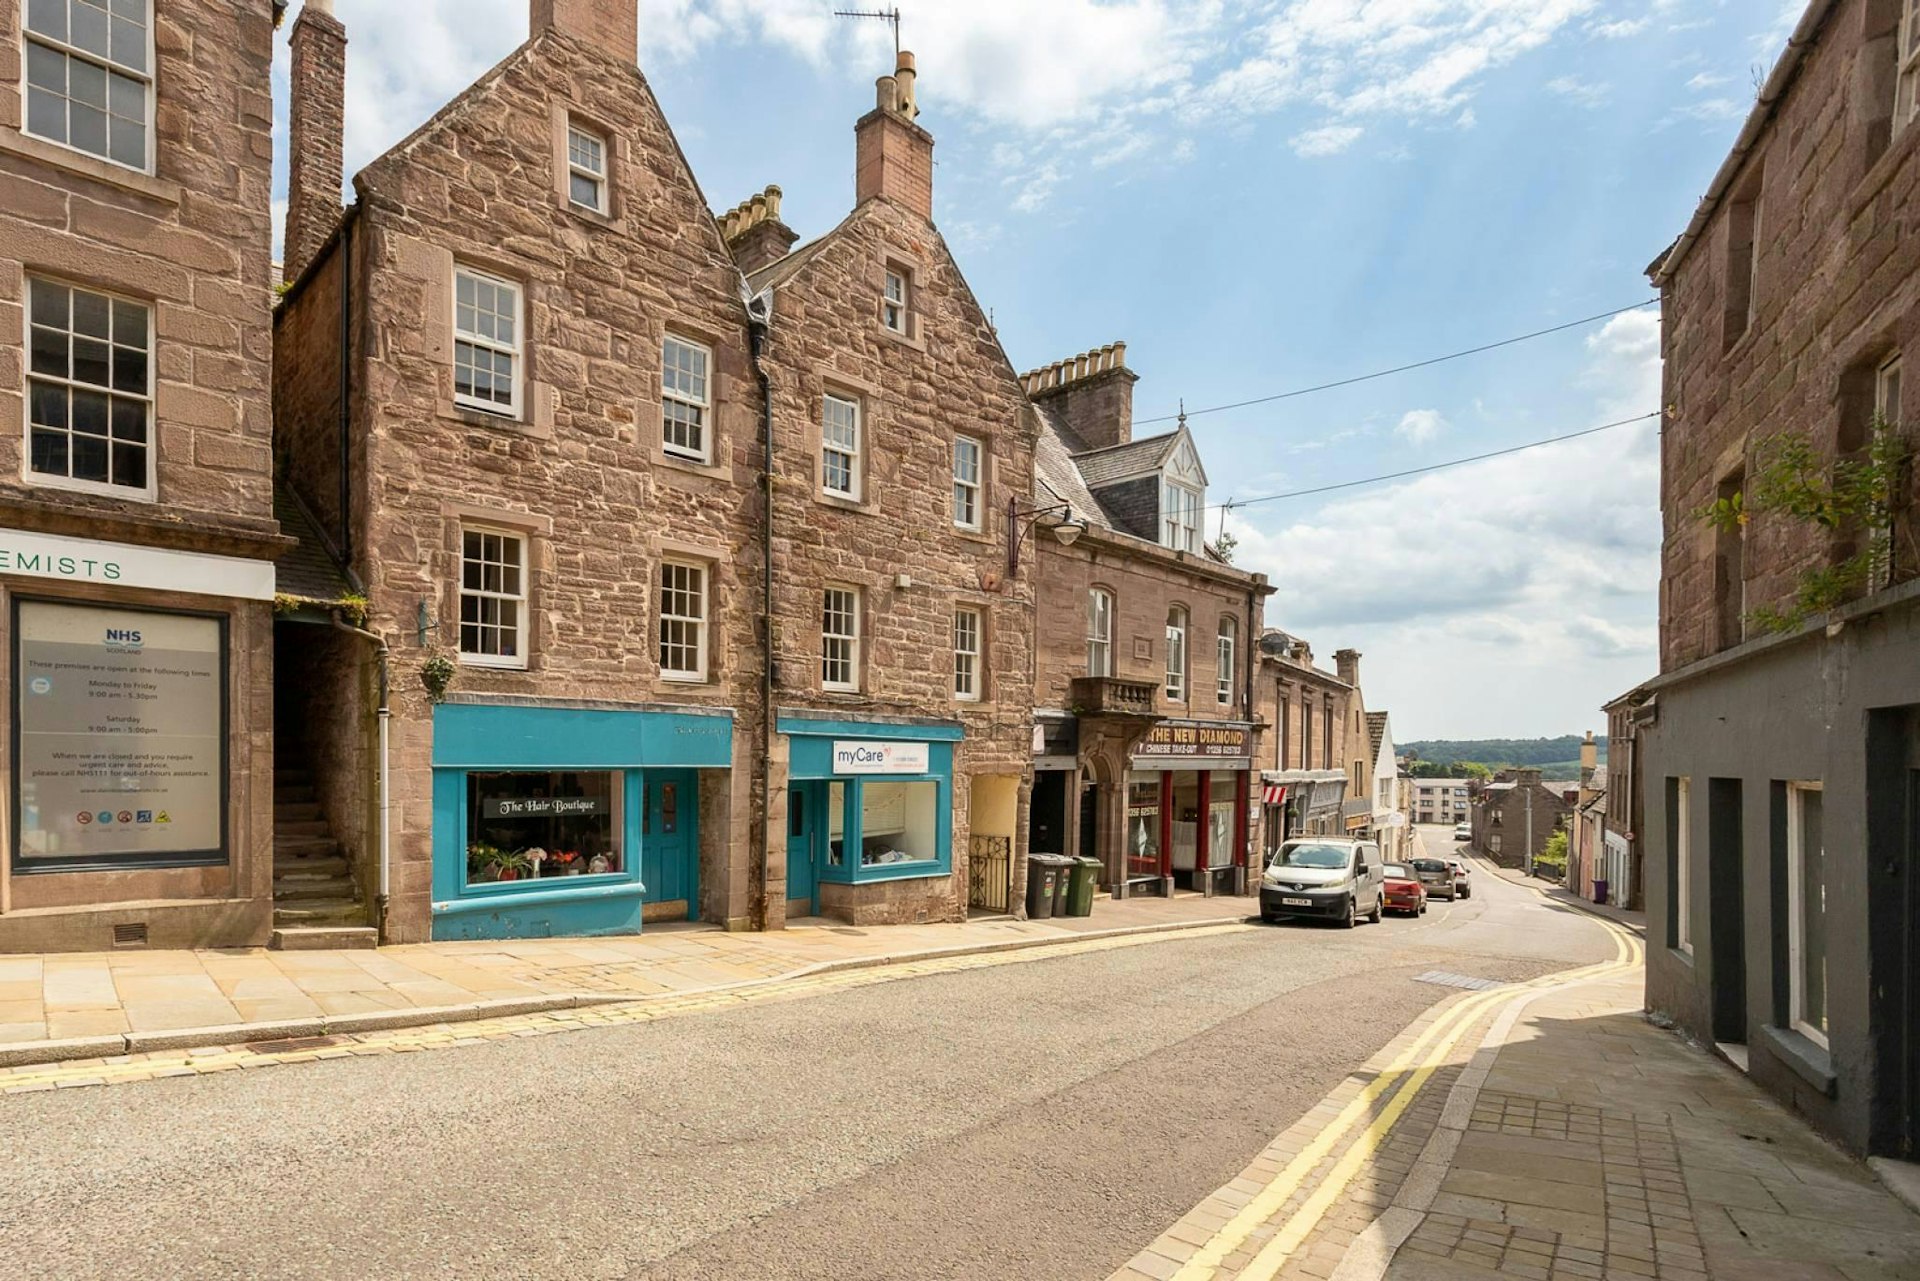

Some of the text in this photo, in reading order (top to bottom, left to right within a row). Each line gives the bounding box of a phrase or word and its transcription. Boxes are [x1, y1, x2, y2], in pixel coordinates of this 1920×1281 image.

[106, 629, 142, 642] NHS
[106, 647, 142, 655] SCOTLAND
[29, 660, 53, 668] These
[54, 662, 90, 670] premises
[154, 668, 190, 677] following
[88, 680, 121, 689] Monday
[106, 715, 141, 723] Saturday
[1150, 727, 1243, 745] THE NEW DIAMOND
[1146, 744, 1171, 754] CHINESE
[838, 747, 884, 765] myCare
[500, 799, 595, 815] The Hair Boutique
